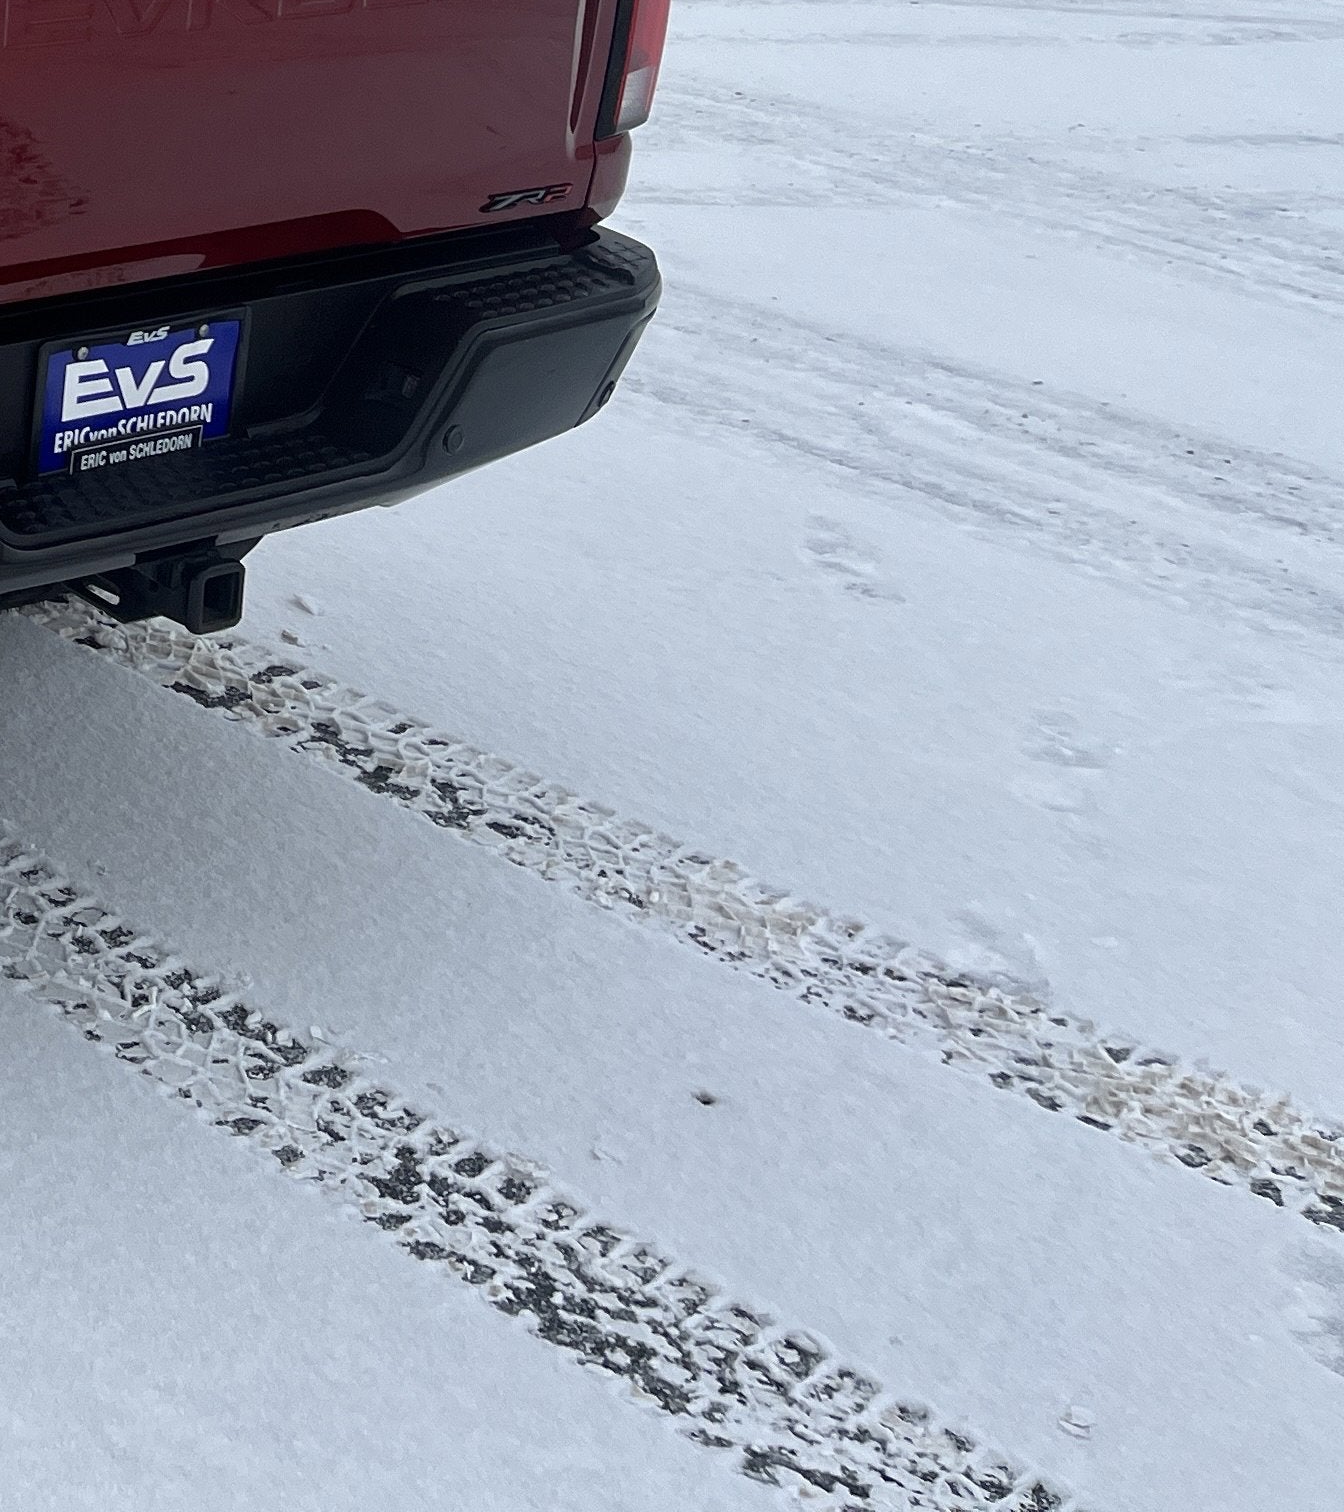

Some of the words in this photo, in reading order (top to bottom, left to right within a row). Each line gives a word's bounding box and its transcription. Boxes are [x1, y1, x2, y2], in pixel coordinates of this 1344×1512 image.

[80, 450, 107, 470] ERIC
[109, 449, 127, 464] von
[129, 433, 193, 460] SCHLEDORN
